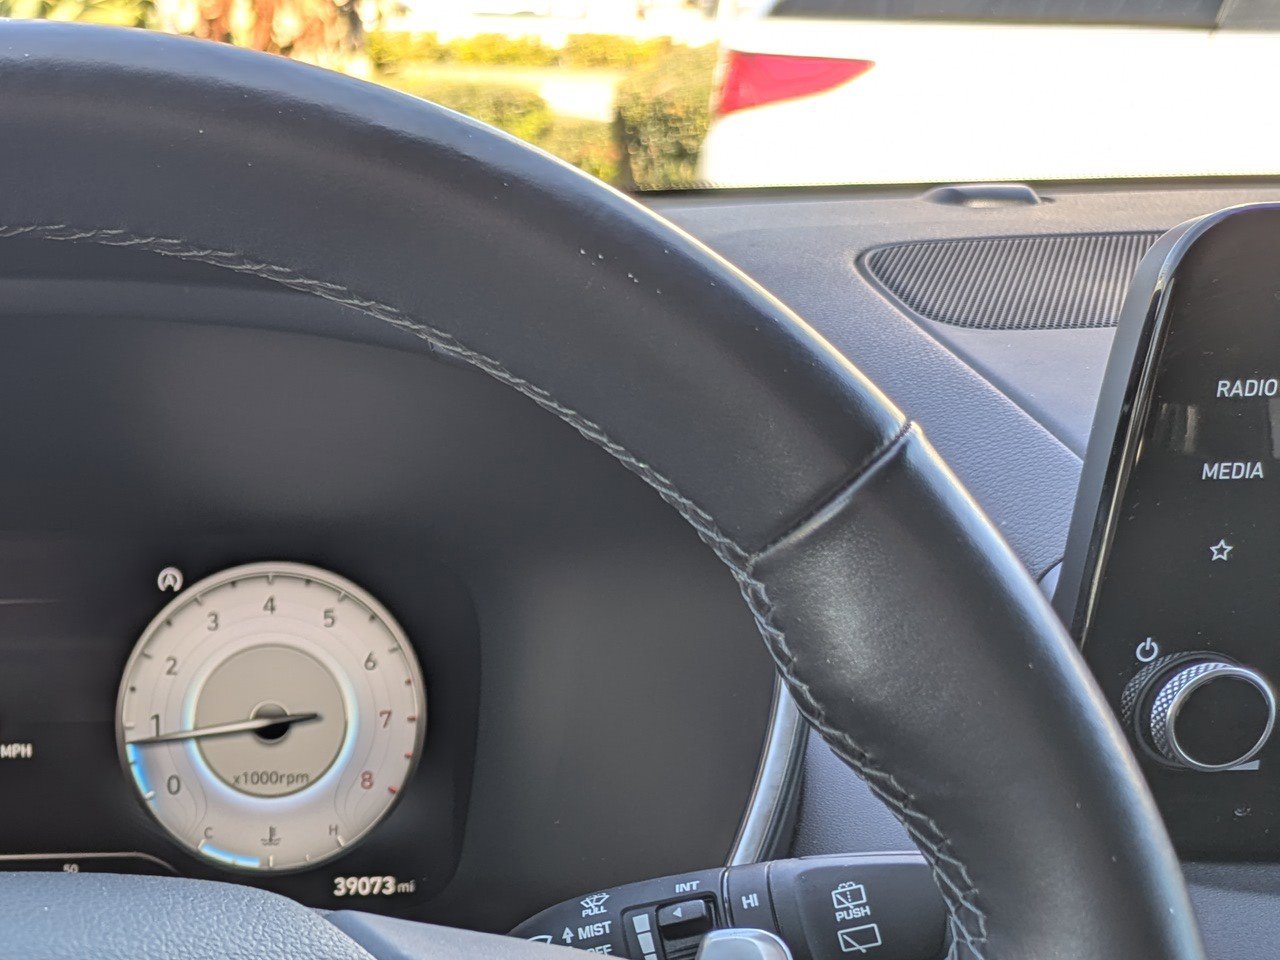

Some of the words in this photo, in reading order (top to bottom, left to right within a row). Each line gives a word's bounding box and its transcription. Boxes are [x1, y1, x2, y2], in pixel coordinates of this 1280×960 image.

[1216, 379, 1278, 397] RADIO
[1201, 461, 1264, 481] MEDIA
[263, 596, 276, 614] 4
[206, 612, 219, 631] 3
[323, 609, 336, 628] 5
[165, 657, 178, 676] 2
[364, 653, 377, 671] 6
[151, 714, 161, 737] 1
[379, 711, 392, 729] 7
[0, 743, 33, 759] MPH
[167, 775, 180, 795] 0
[233, 771, 310, 787] x1000rpm
[361, 771, 374, 789] 8
[204, 827, 213, 839] C
[329, 824, 338, 836] H
[675, 880, 700, 893] INT
[742, 893, 759, 910] HI
[581, 905, 608, 918] PULL
[835, 904, 871, 922] PUSH
[577, 920, 612, 940] MIST
